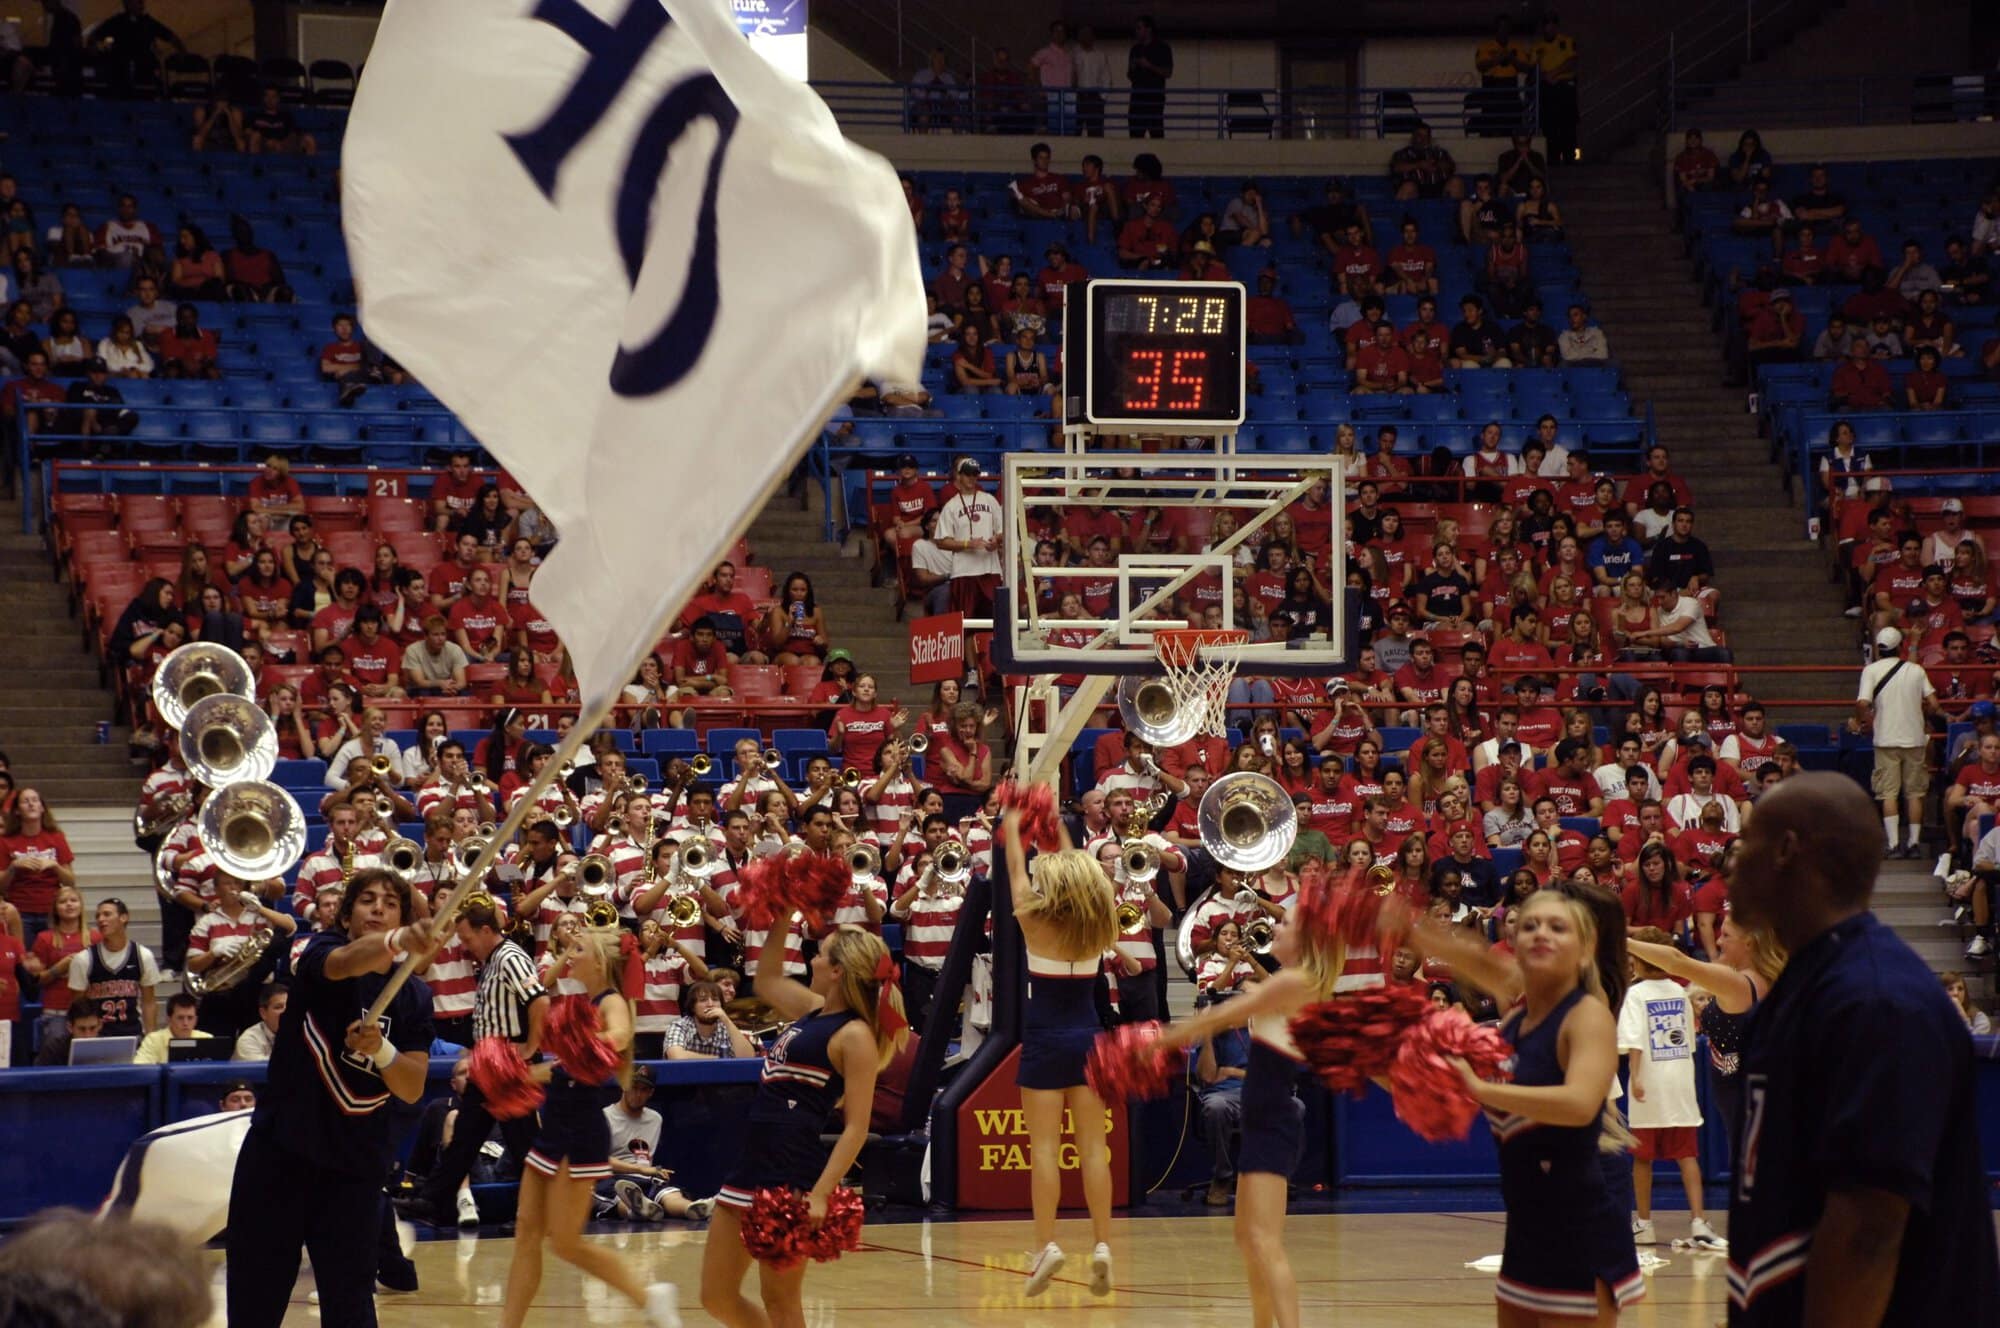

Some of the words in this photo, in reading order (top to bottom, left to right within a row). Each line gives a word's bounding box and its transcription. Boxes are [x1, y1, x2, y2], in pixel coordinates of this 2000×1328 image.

[1138, 297, 1225, 334] 7:28
[1125, 351, 1207, 410] 35
[375, 479, 399, 497] 21
[527, 713, 549, 731] 21
[974, 1108, 1114, 1136] WELS
[979, 1143, 1112, 1171] FAG
